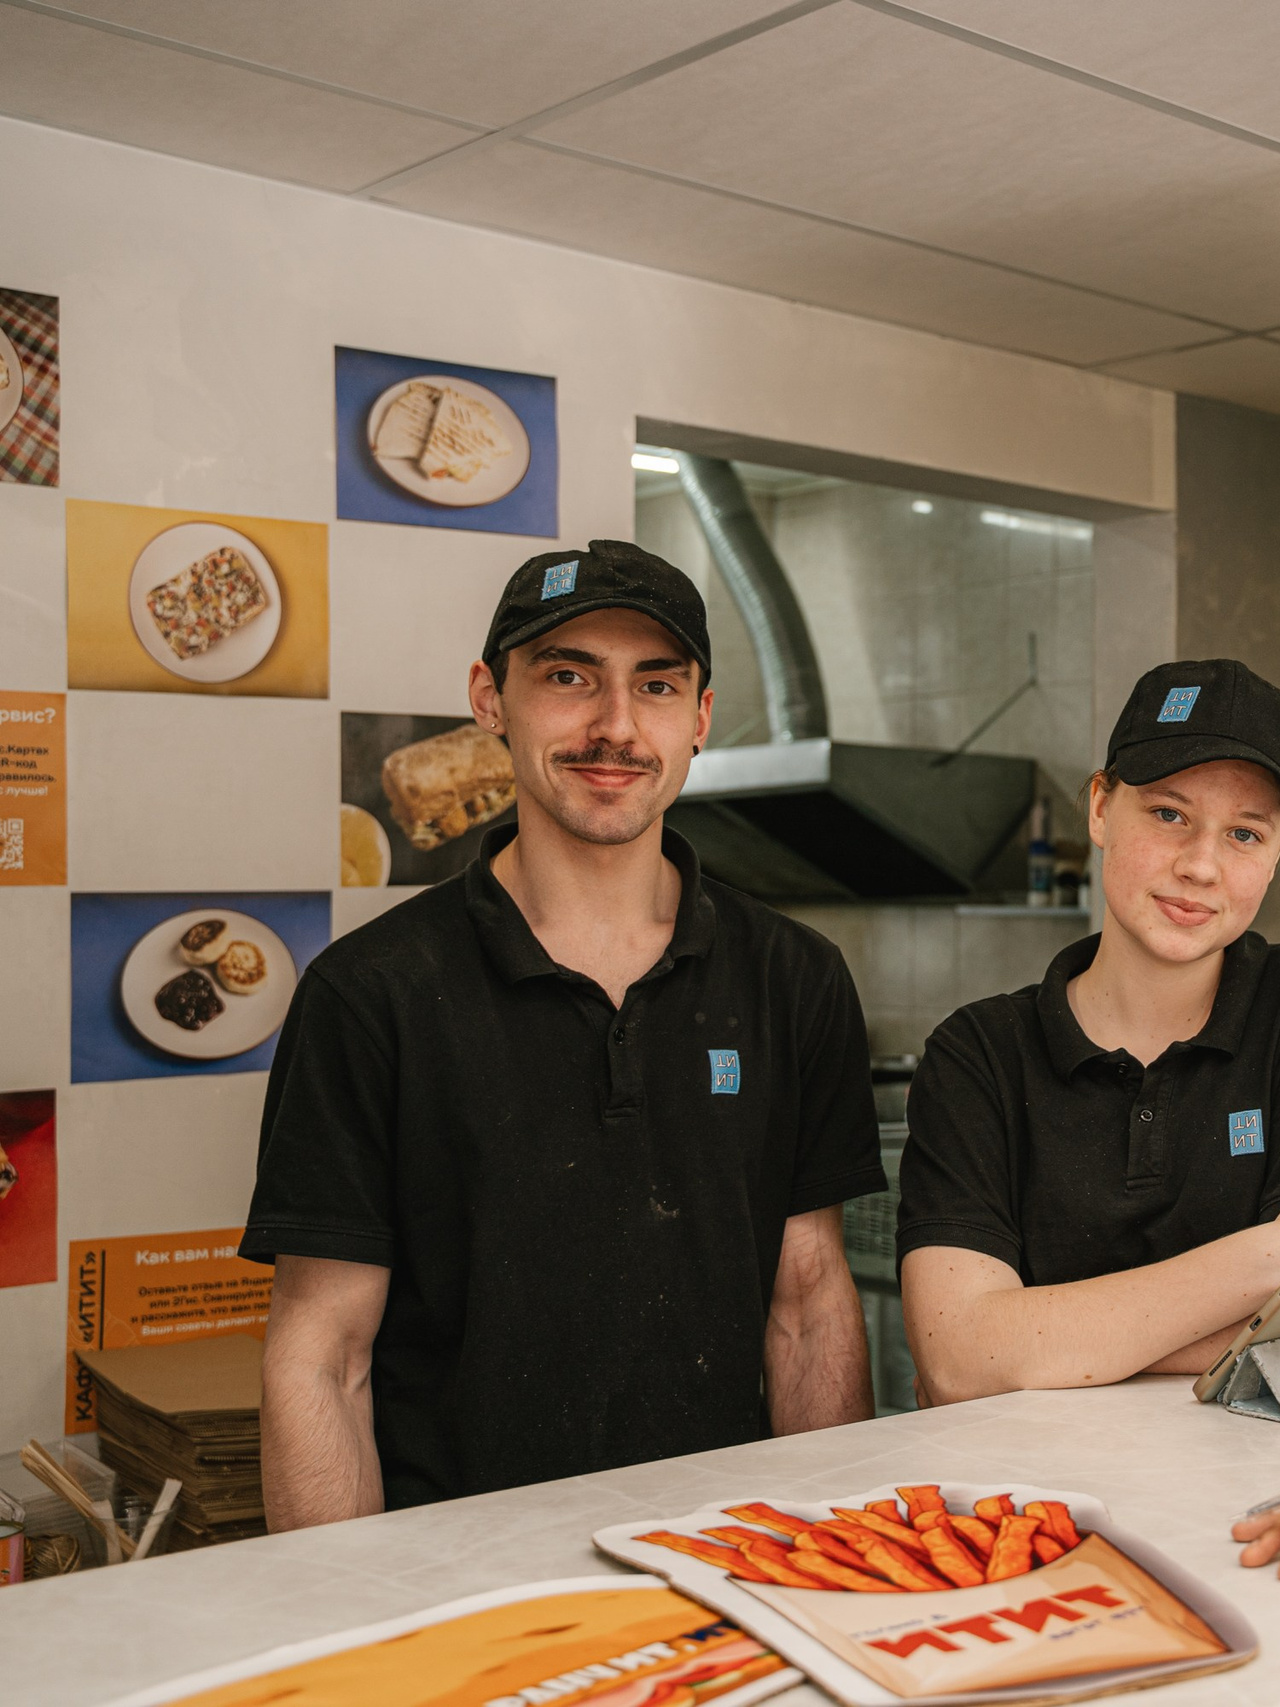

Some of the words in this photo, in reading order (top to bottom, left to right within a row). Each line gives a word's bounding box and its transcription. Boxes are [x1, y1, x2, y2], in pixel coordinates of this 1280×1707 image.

[1163, 705, 1187, 717] ИТ
[716, 1073, 737, 1088] ИТ
[1234, 1133, 1258, 1149] ИТ
[136, 1249, 170, 1266] Как
[174, 1247, 209, 1263] вам
[78, 1251, 97, 1343] «ИТИТ»
[150, 1299, 170, 1309] или
[141, 1324, 173, 1337] Ваши
[174, 1320, 214, 1333] советы
[217, 1315, 255, 1329] делают
[76, 1355, 93, 1422] КАФ
[864, 1584, 1127, 1659] ИТИТ
